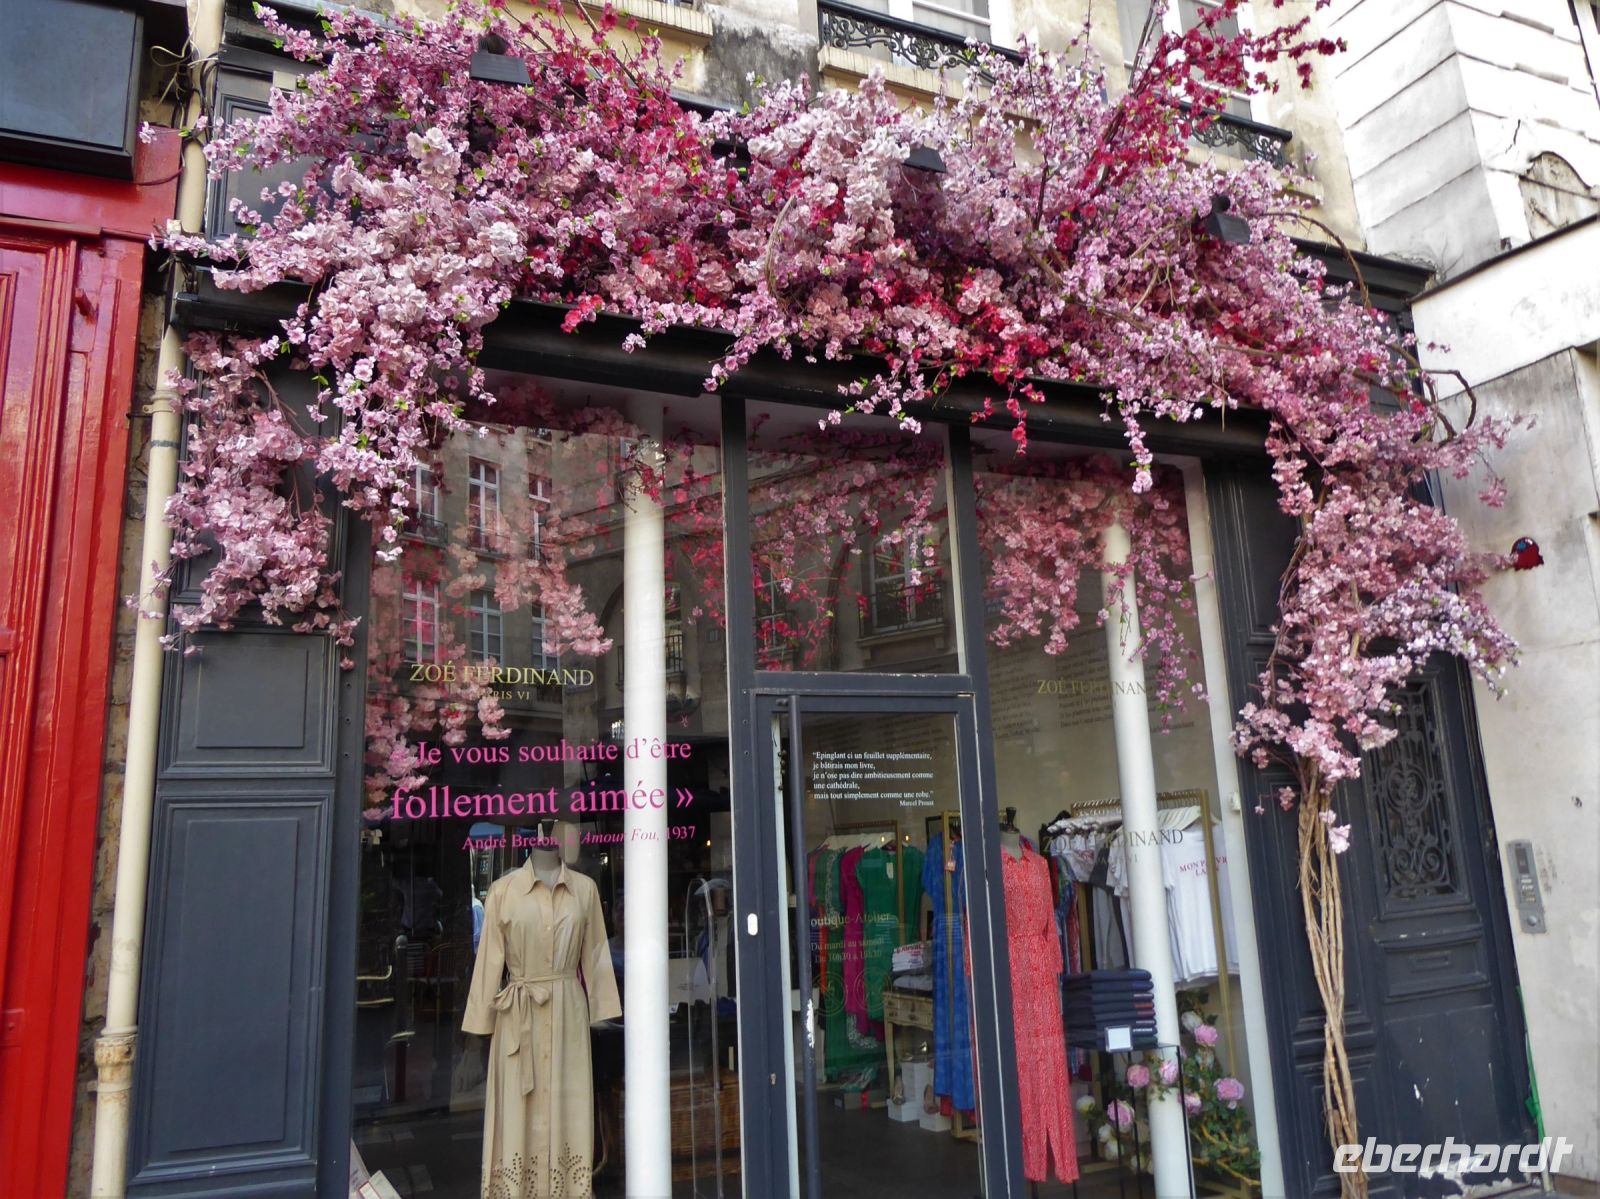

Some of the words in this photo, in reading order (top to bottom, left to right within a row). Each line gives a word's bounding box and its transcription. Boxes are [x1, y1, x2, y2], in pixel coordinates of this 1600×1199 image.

[410, 661, 456, 682] ZOÉ
[463, 665, 595, 686] FERDINAND
[517, 691, 530, 700] VI
[416, 741, 442, 765] Je
[450, 745, 510, 764] vous
[518, 738, 619, 762] souhaite
[626, 737, 692, 760] d’être
[864, 751, 885, 760] feuillet
[812, 761, 819, 771] je
[859, 761, 876, 770] livre,
[812, 771, 820, 781] je
[839, 773, 850, 781] pas
[851, 771, 863, 779] dire
[826, 781, 861, 790] cathédrale,
[390, 786, 560, 819] follement
[570, 780, 665, 813] aimée
[813, 792, 829, 800] mais
[843, 791, 879, 801] simplement
[462, 833, 507, 849] André
[666, 825, 697, 840] 1937
